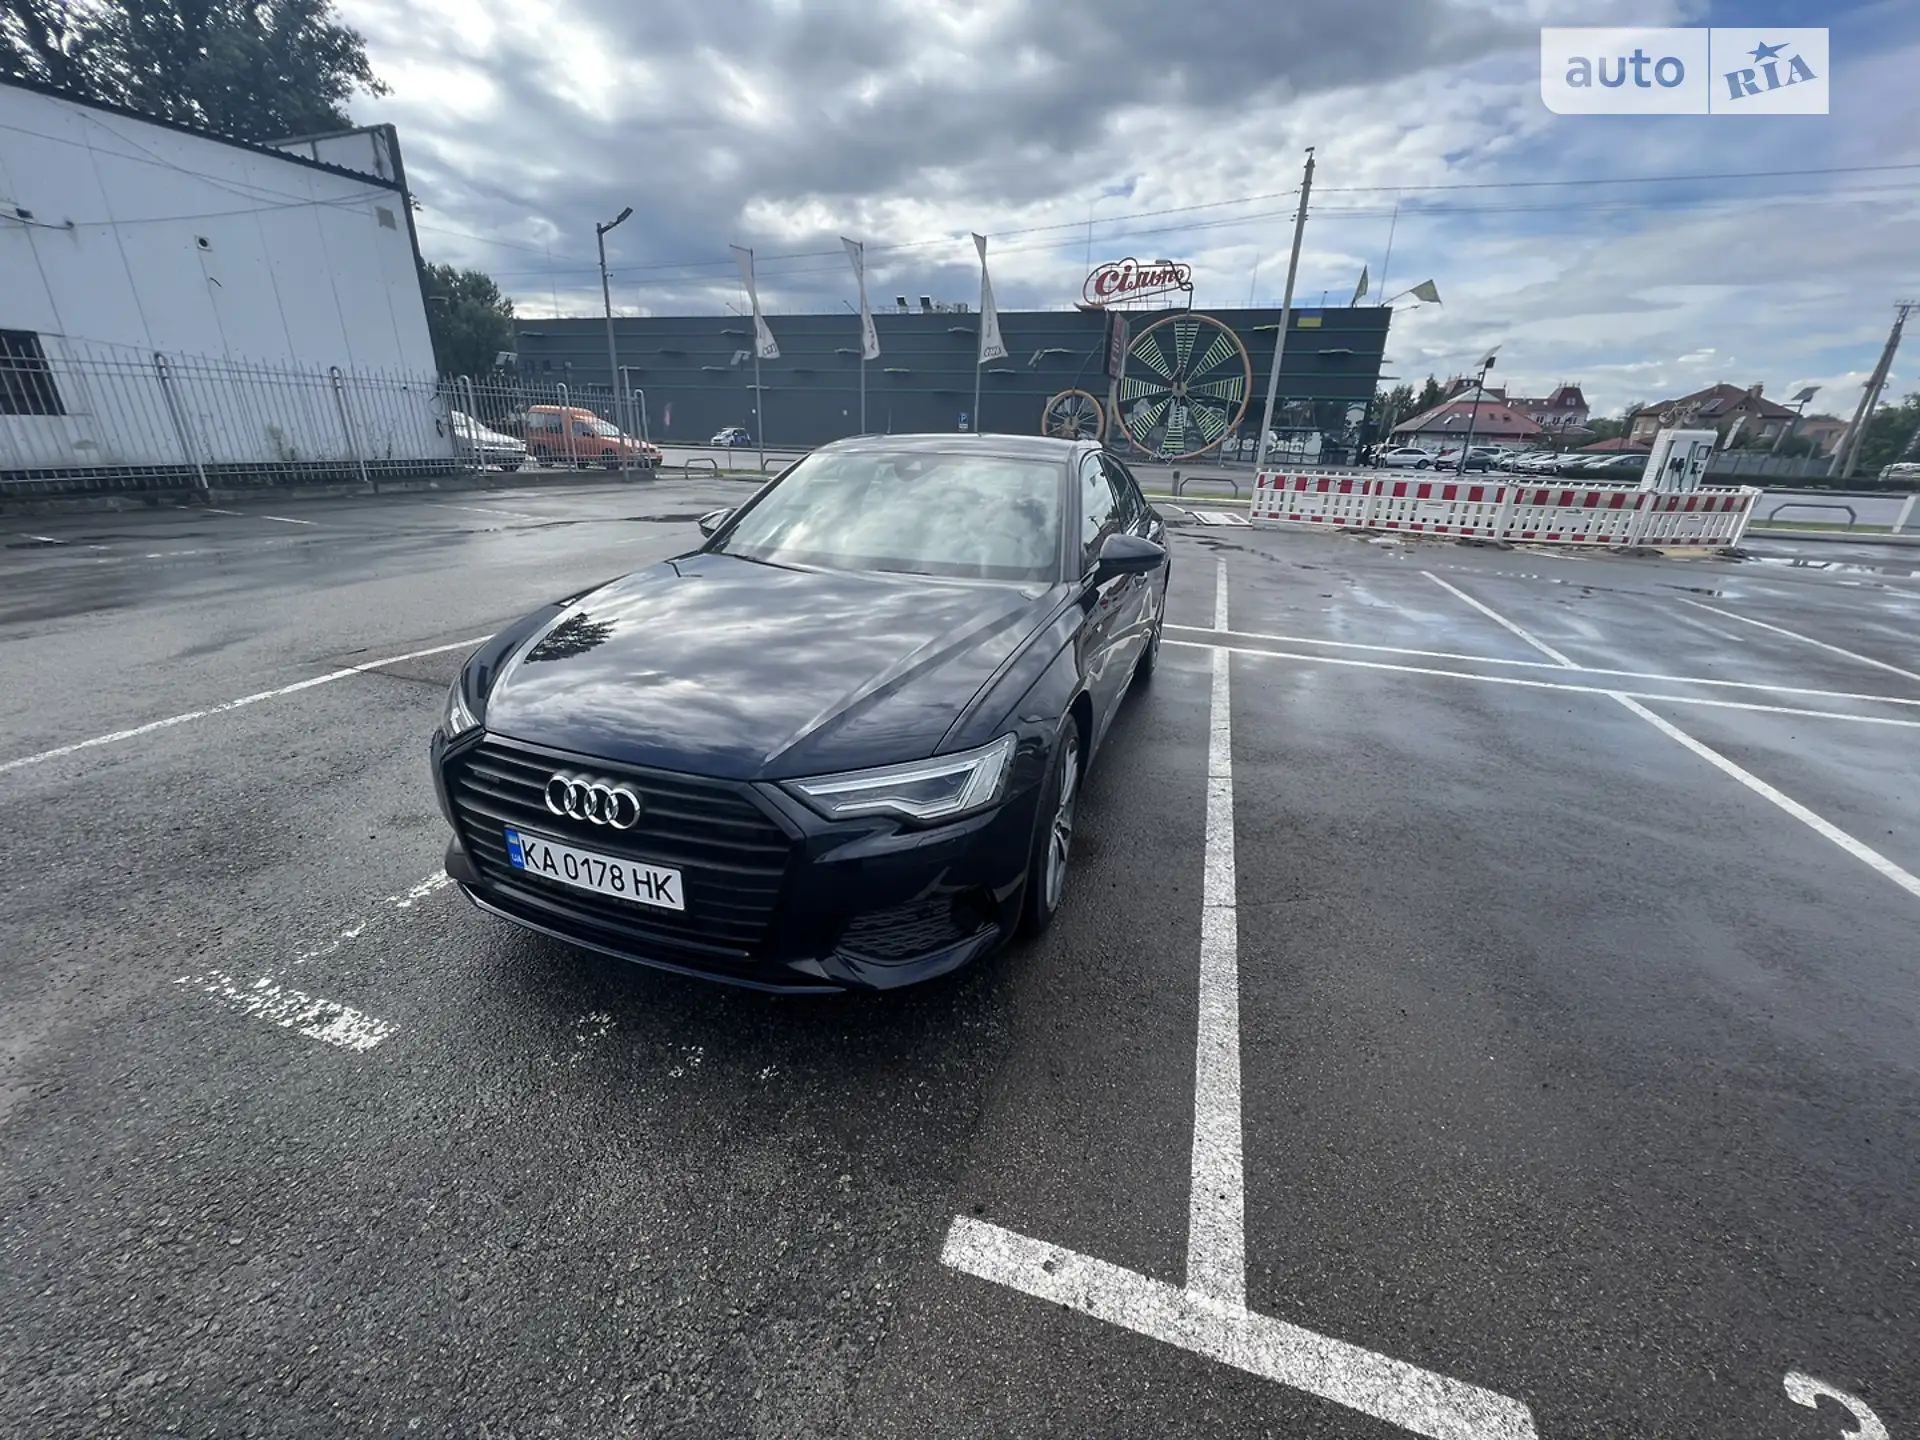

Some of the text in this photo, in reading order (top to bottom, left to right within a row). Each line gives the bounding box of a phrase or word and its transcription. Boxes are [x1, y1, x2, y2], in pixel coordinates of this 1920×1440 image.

[521, 839, 559, 876] KA
[563, 853, 625, 892] 0178
[632, 868, 675, 903] HK
